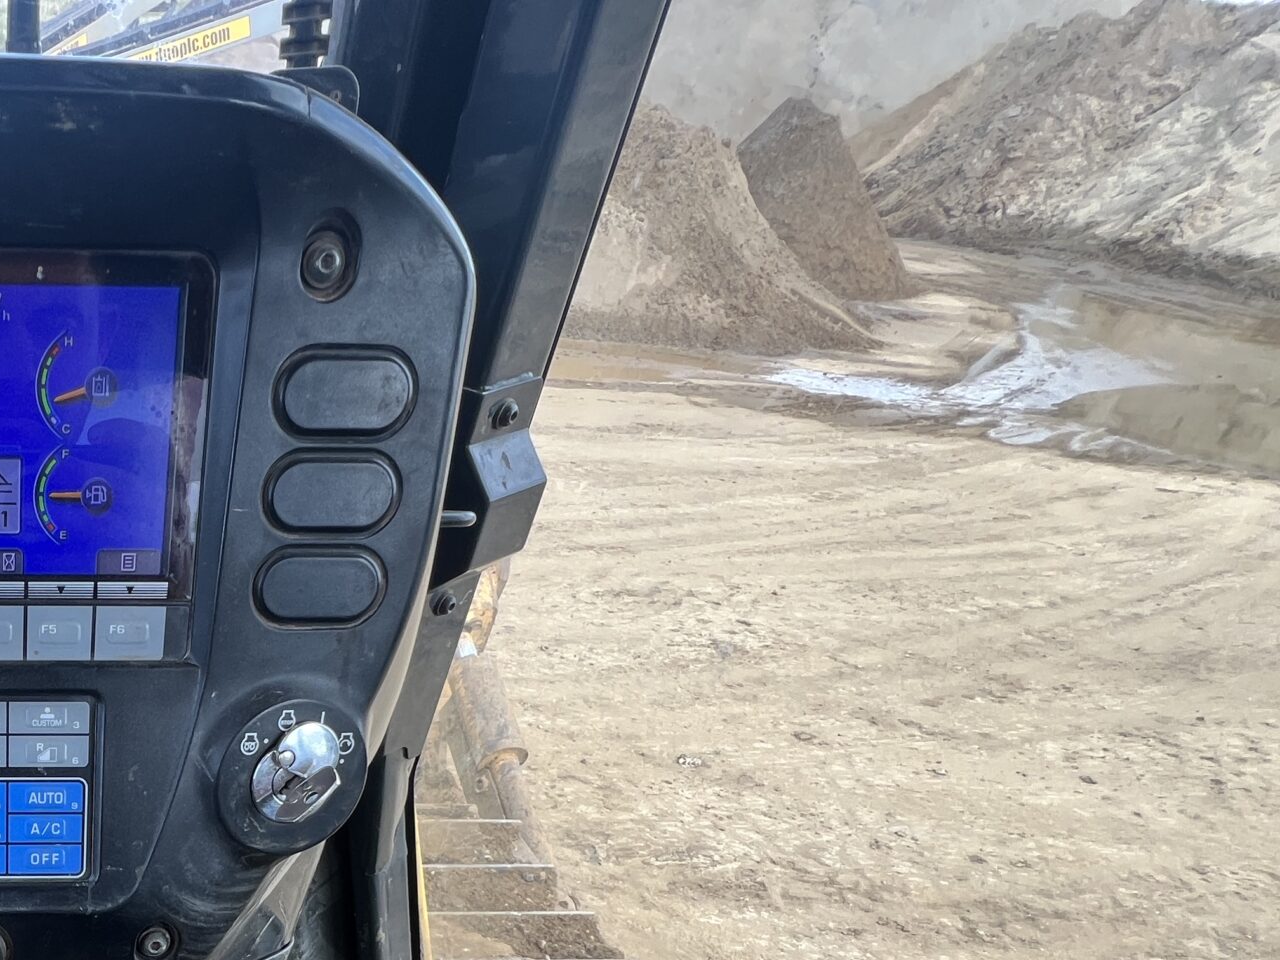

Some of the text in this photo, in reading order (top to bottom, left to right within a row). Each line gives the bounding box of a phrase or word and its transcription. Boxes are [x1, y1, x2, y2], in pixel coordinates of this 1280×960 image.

[64, 337, 73, 347] H
[61, 424, 70, 433] C
[61, 449, 70, 459] F
[59, 530, 67, 539] E
[41, 624, 57, 635] F5
[109, 624, 125, 635] F6
[31, 719, 63, 728] CUSTOM
[72, 721, 80, 729] 3
[36, 742, 44, 752] R
[28, 791, 63, 805] AUTO
[71, 802, 78, 810] 9
[30, 821, 61, 836] A/C
[30, 852, 60, 865] OFF
